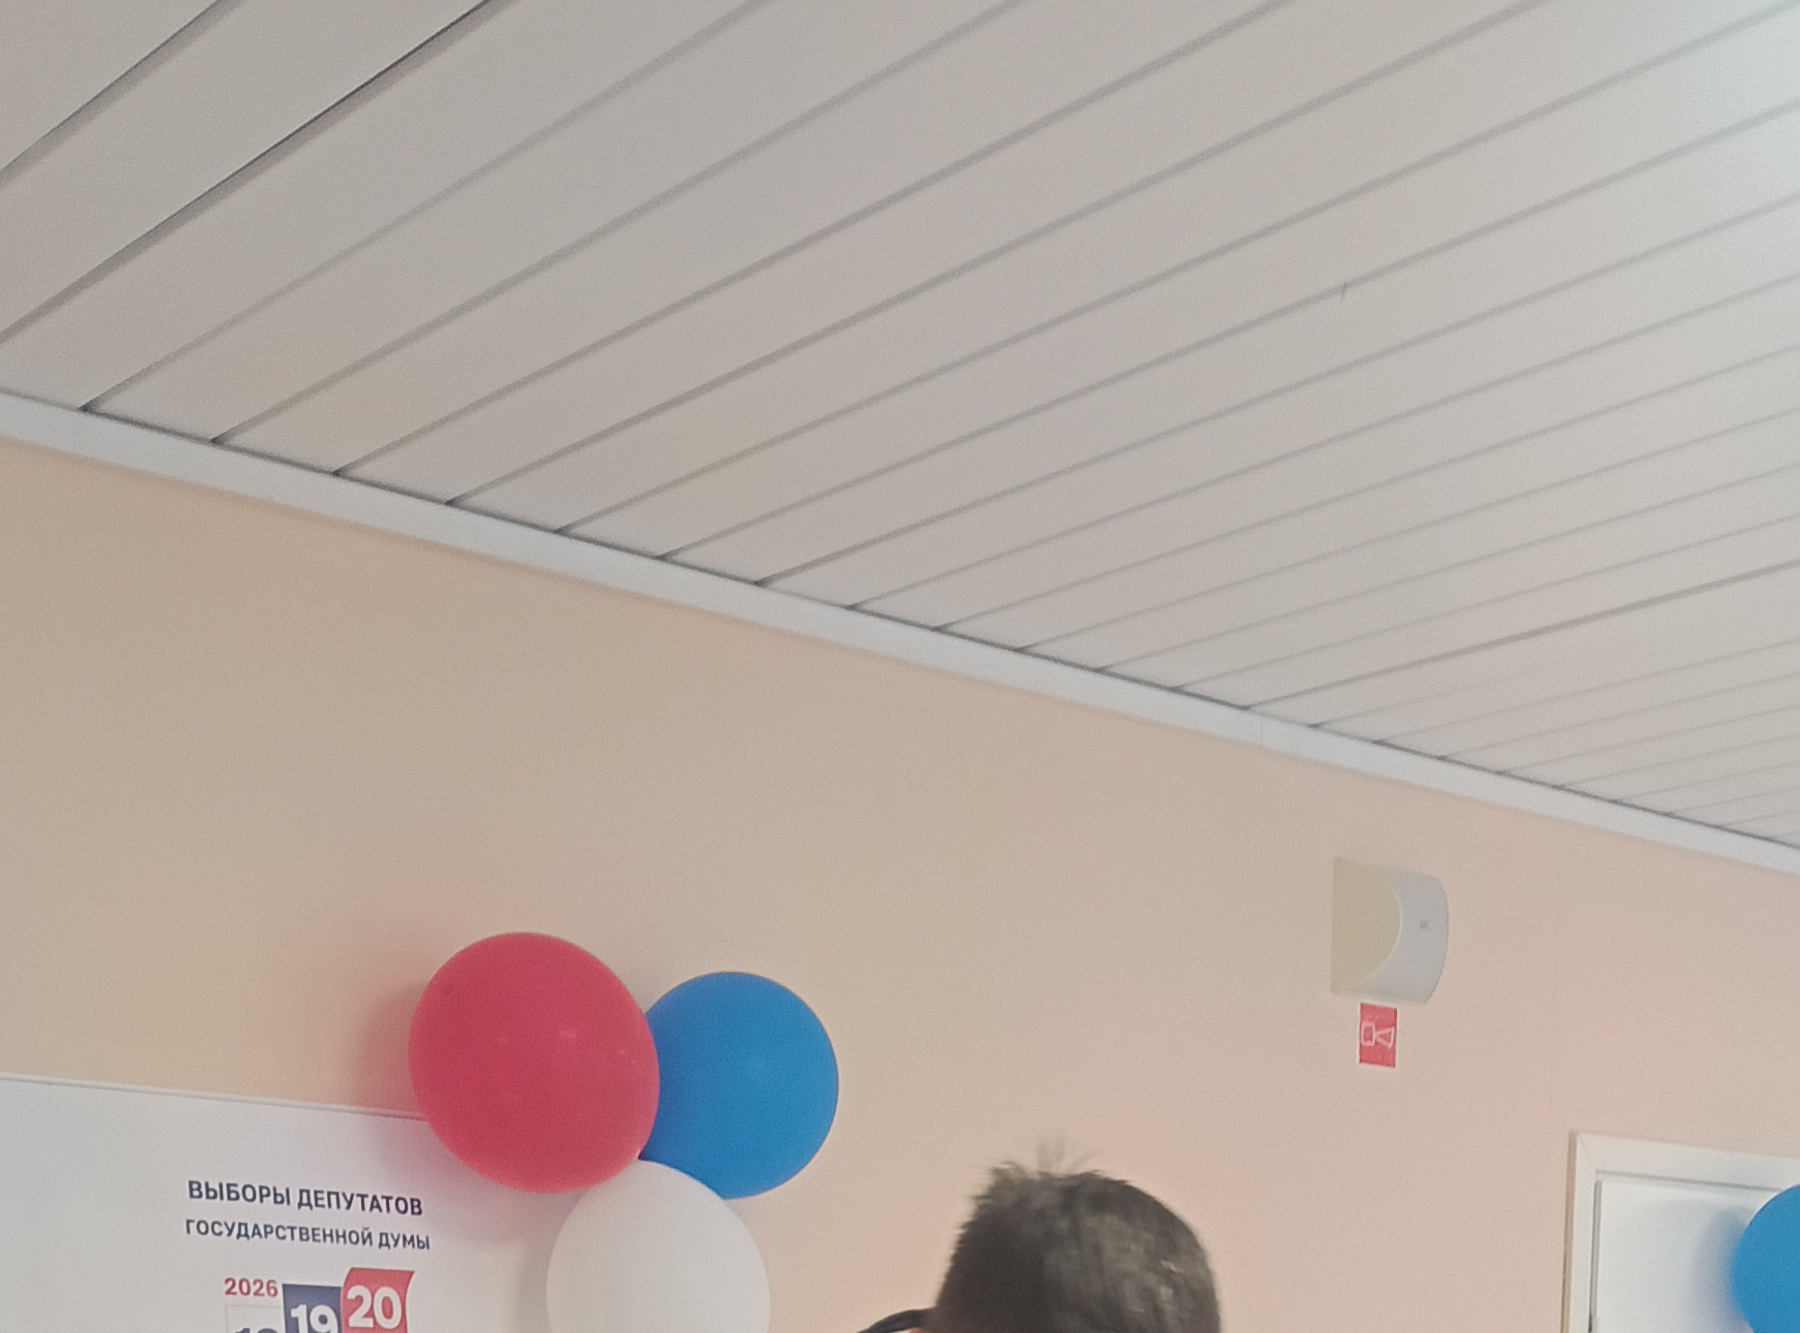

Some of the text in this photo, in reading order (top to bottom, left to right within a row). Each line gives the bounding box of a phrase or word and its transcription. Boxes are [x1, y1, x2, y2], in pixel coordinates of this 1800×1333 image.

[188, 1180, 423, 1216] ВЫБОРЫ ДЕПУТАТОВ
[185, 1219, 430, 1250] ГОСУДАРСТВЕННОЙ ДУМЫ
[224, 1277, 279, 1298] 2026
[346, 1285, 402, 1330] 20
